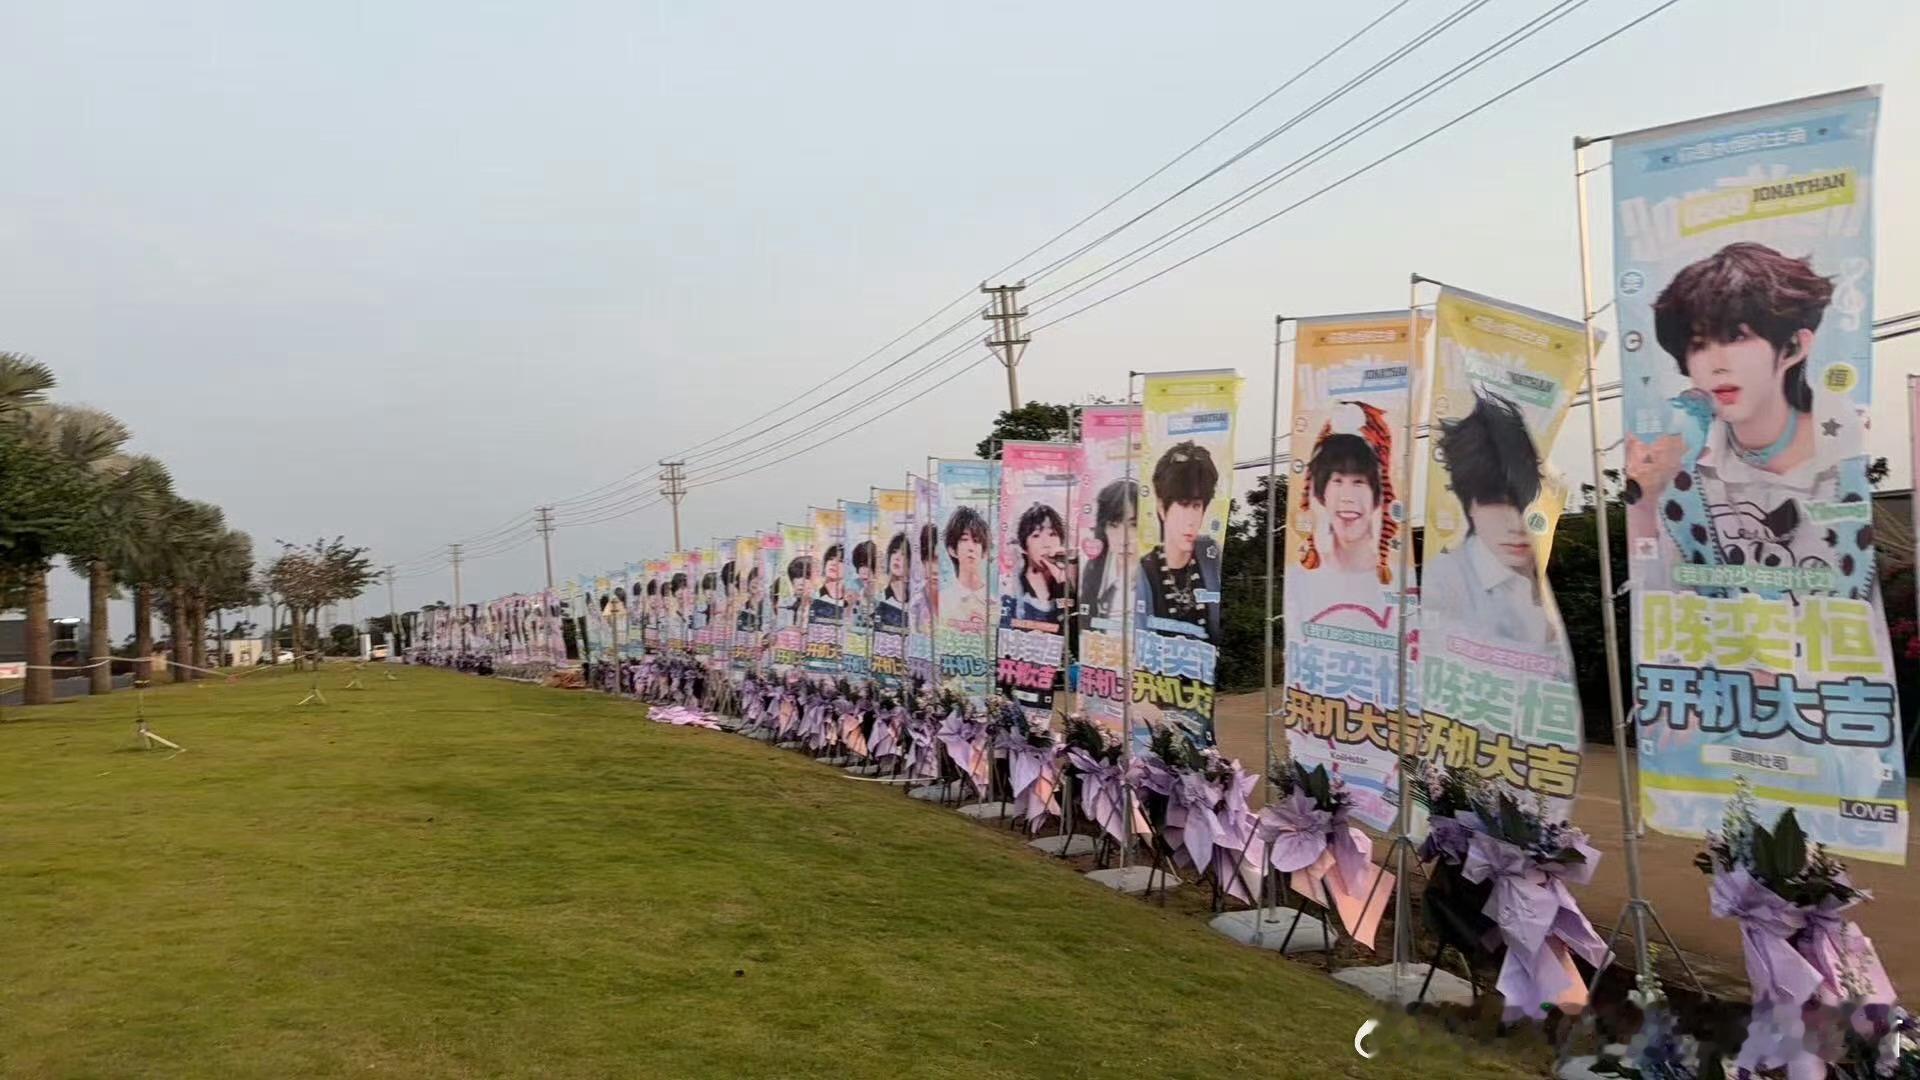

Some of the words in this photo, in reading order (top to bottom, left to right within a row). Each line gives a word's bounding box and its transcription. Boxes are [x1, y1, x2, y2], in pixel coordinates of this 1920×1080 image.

[1752, 173, 1846, 202] JONATHAN
[1641, 594, 1886, 673] 陈奕恒
[1283, 686, 1420, 759] 开机大吉
[1423, 655, 1578, 745] 陈奕恒
[1636, 663, 1895, 748] 开机大吉
[1420, 708, 1582, 799] 开机大吉
[1841, 800, 1895, 821] LOVE
